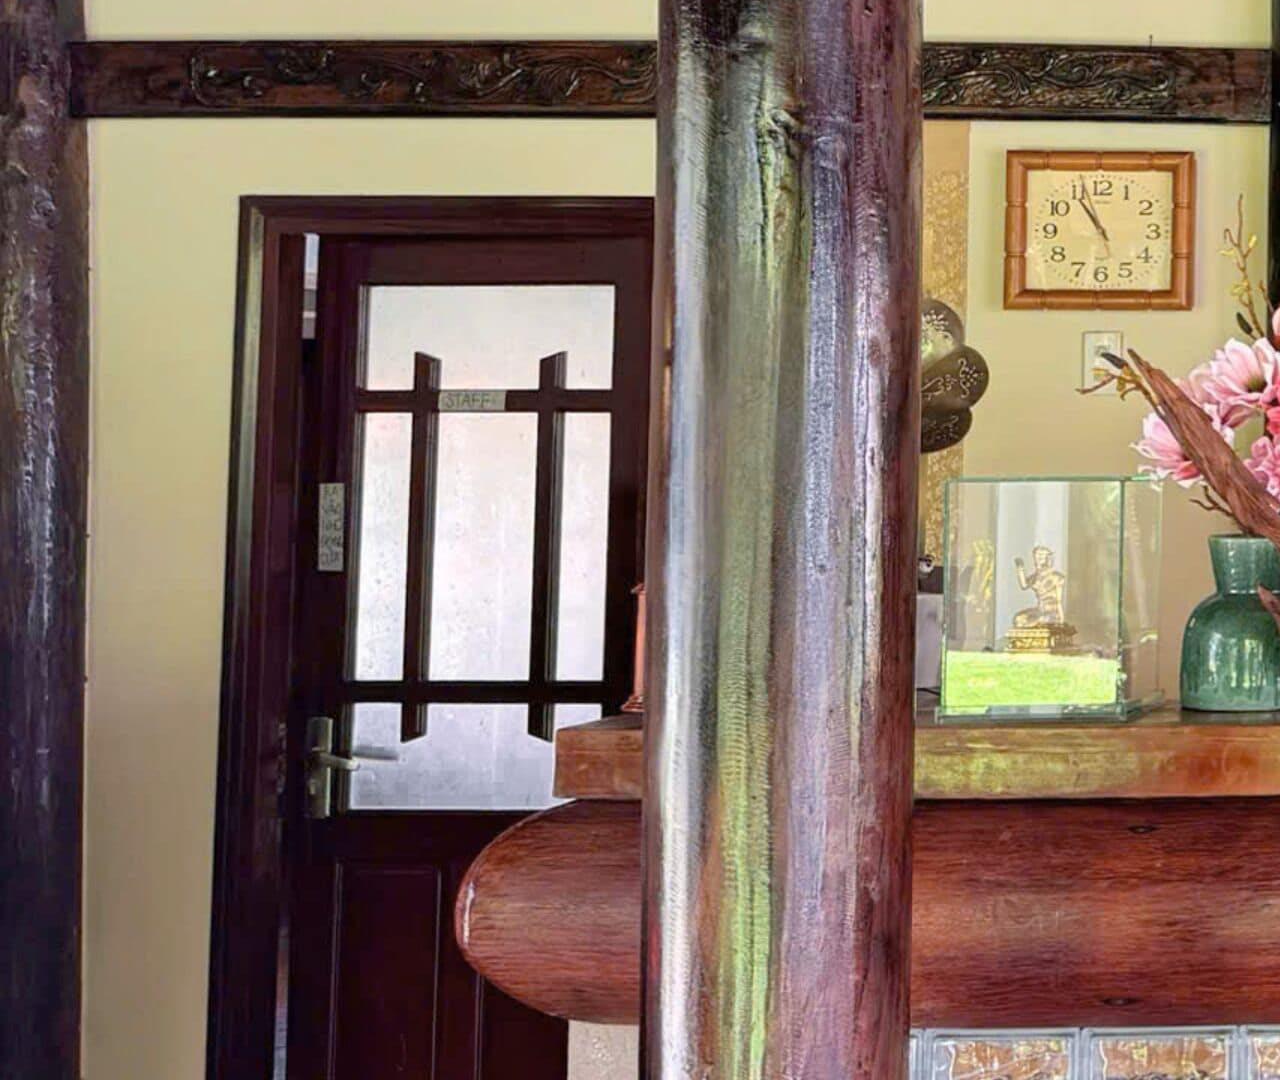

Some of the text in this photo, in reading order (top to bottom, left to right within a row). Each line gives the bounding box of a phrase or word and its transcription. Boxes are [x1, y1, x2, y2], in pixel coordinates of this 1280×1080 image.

[1072, 184, 1085, 200] 11
[1093, 180, 1112, 196] 12
[1124, 184, 1129, 200] 1
[1050, 200, 1070, 216] 10
[1139, 199, 1153, 216] 2
[1043, 223, 1058, 239] 9
[1145, 223, 1161, 240] 3
[1050, 246, 1066, 262] 8
[1136, 246, 1153, 263] 4
[1071, 262, 1086, 277] 7
[1094, 266, 1109, 282] 6
[1118, 262, 1133, 278] 5
[446, 392, 490, 408] STAFF
